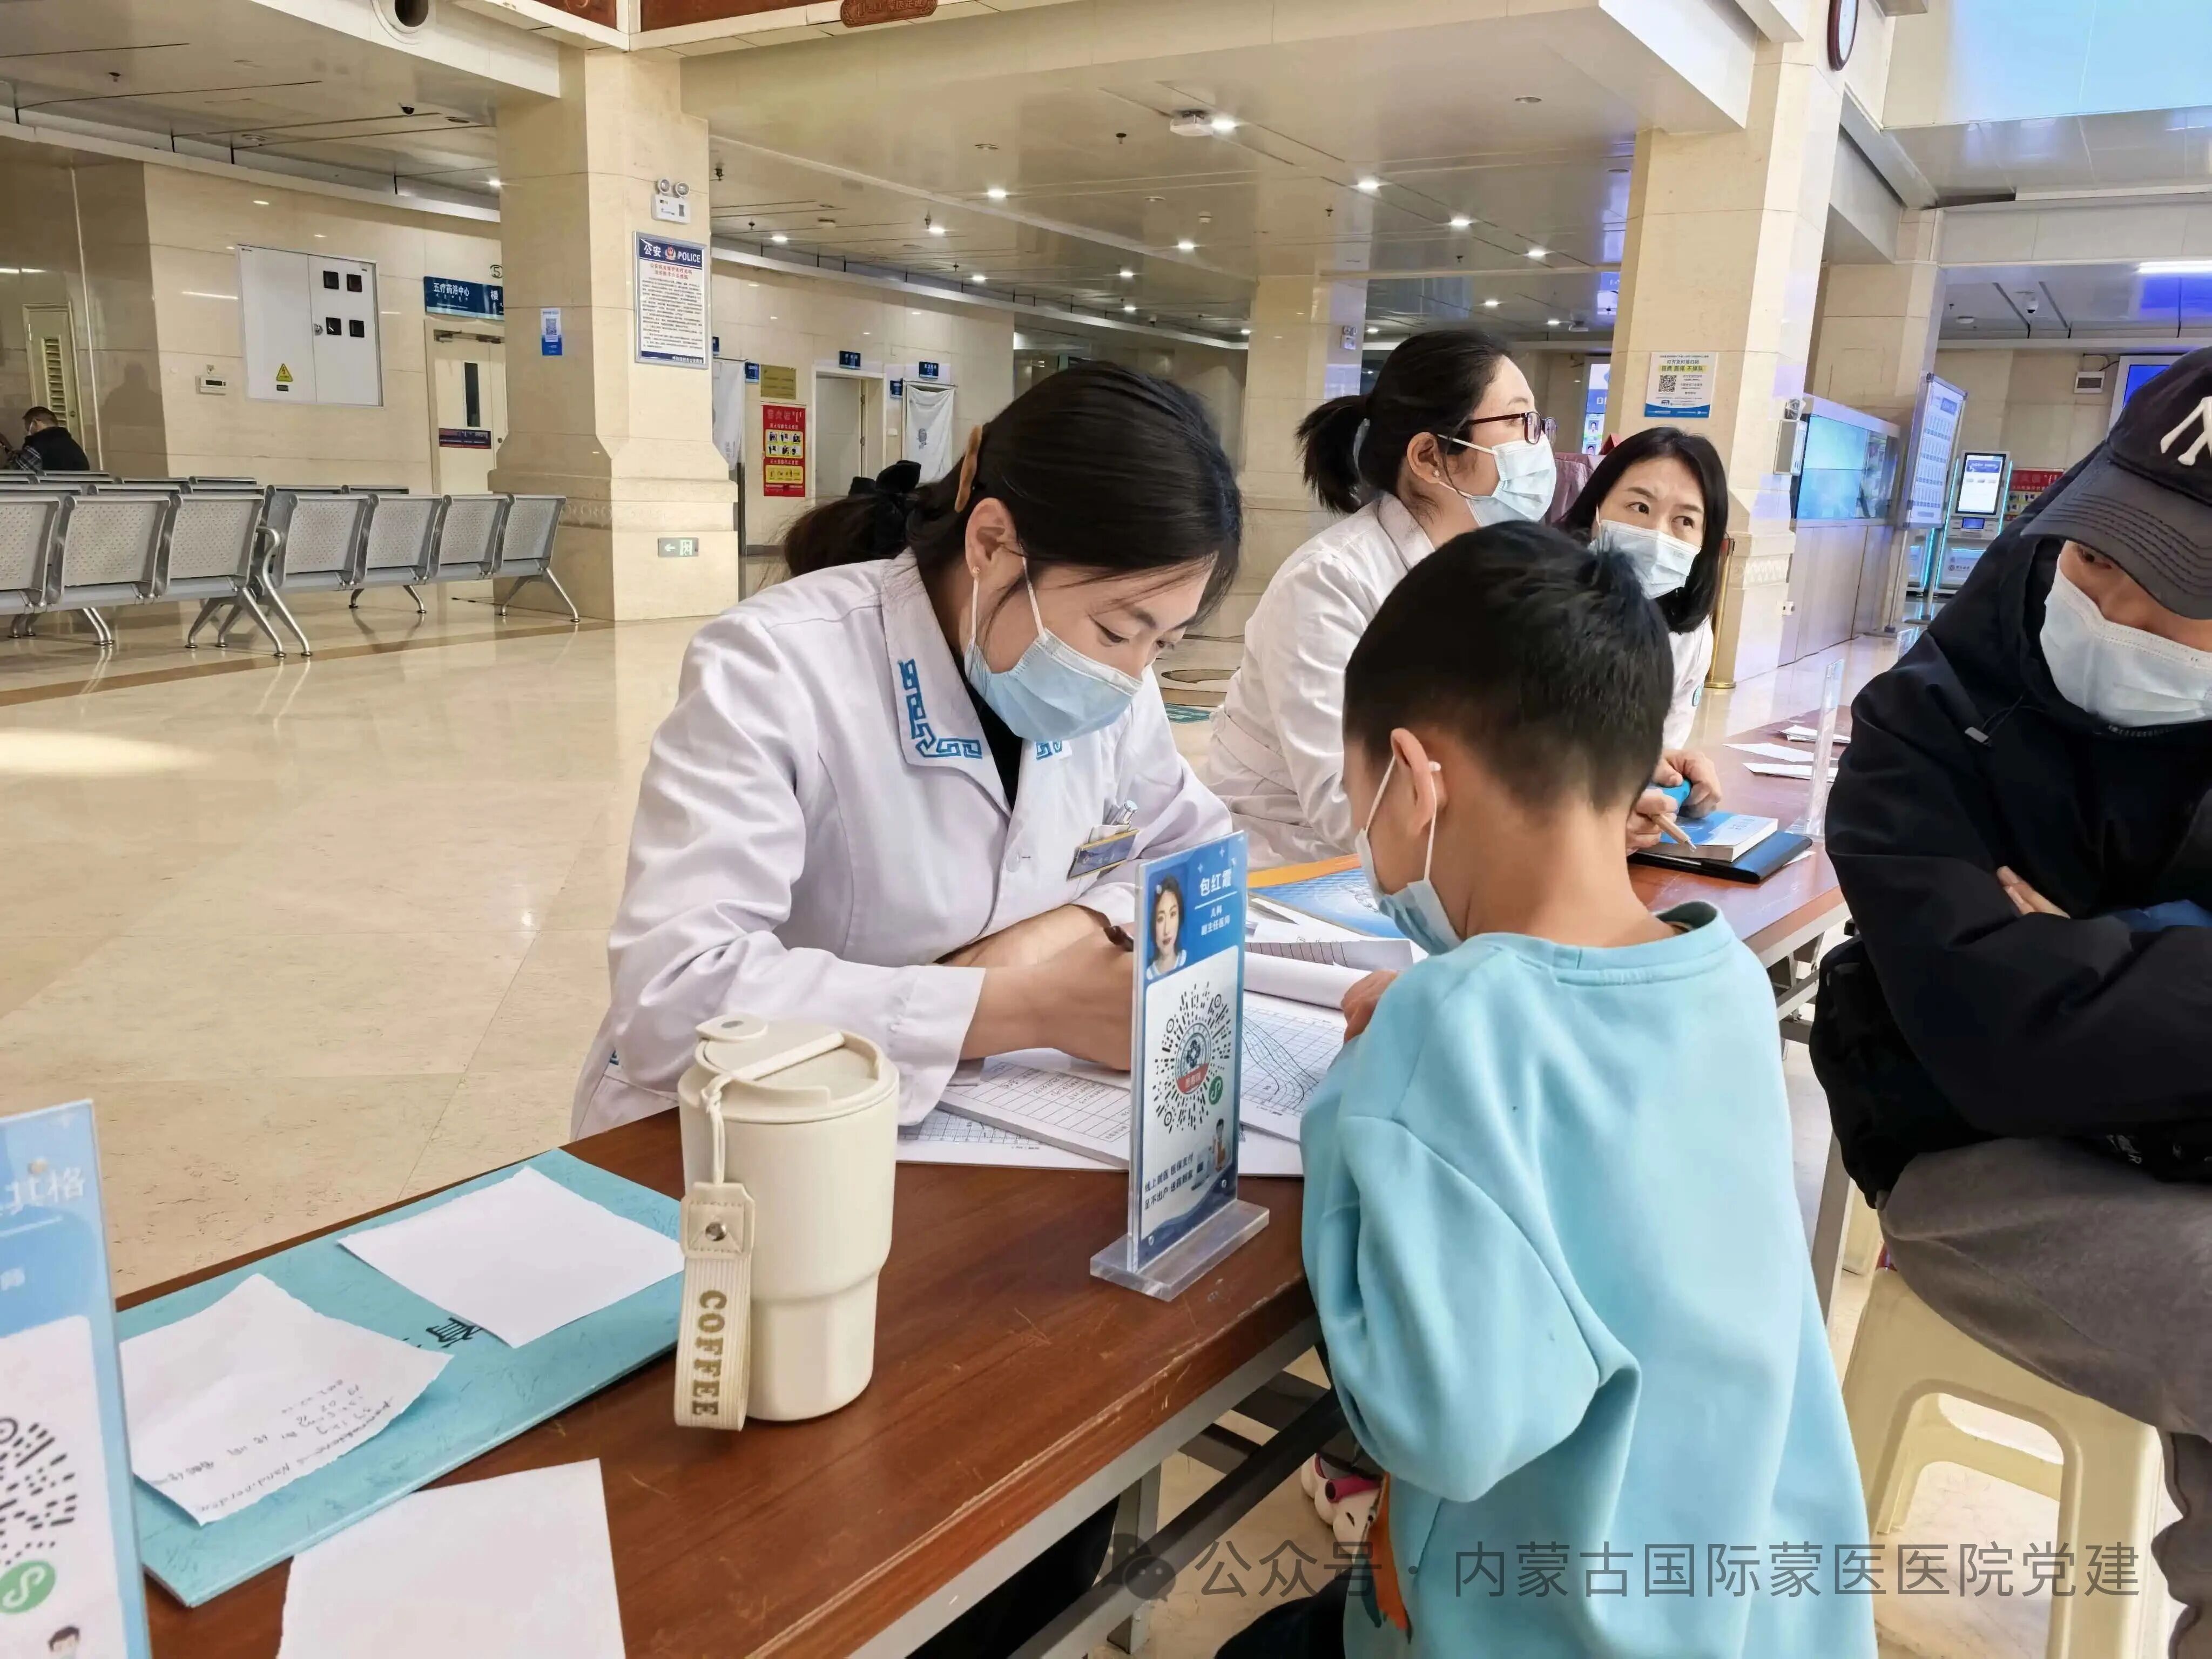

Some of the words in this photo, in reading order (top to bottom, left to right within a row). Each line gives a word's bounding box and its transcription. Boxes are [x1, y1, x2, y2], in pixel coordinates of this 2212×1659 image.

[643, 243, 662, 257] 公安
[678, 251, 701, 263] POLICE
[1201, 915, 1231, 936] 副主任医师
[691, 1290, 727, 1418] COFFEE
